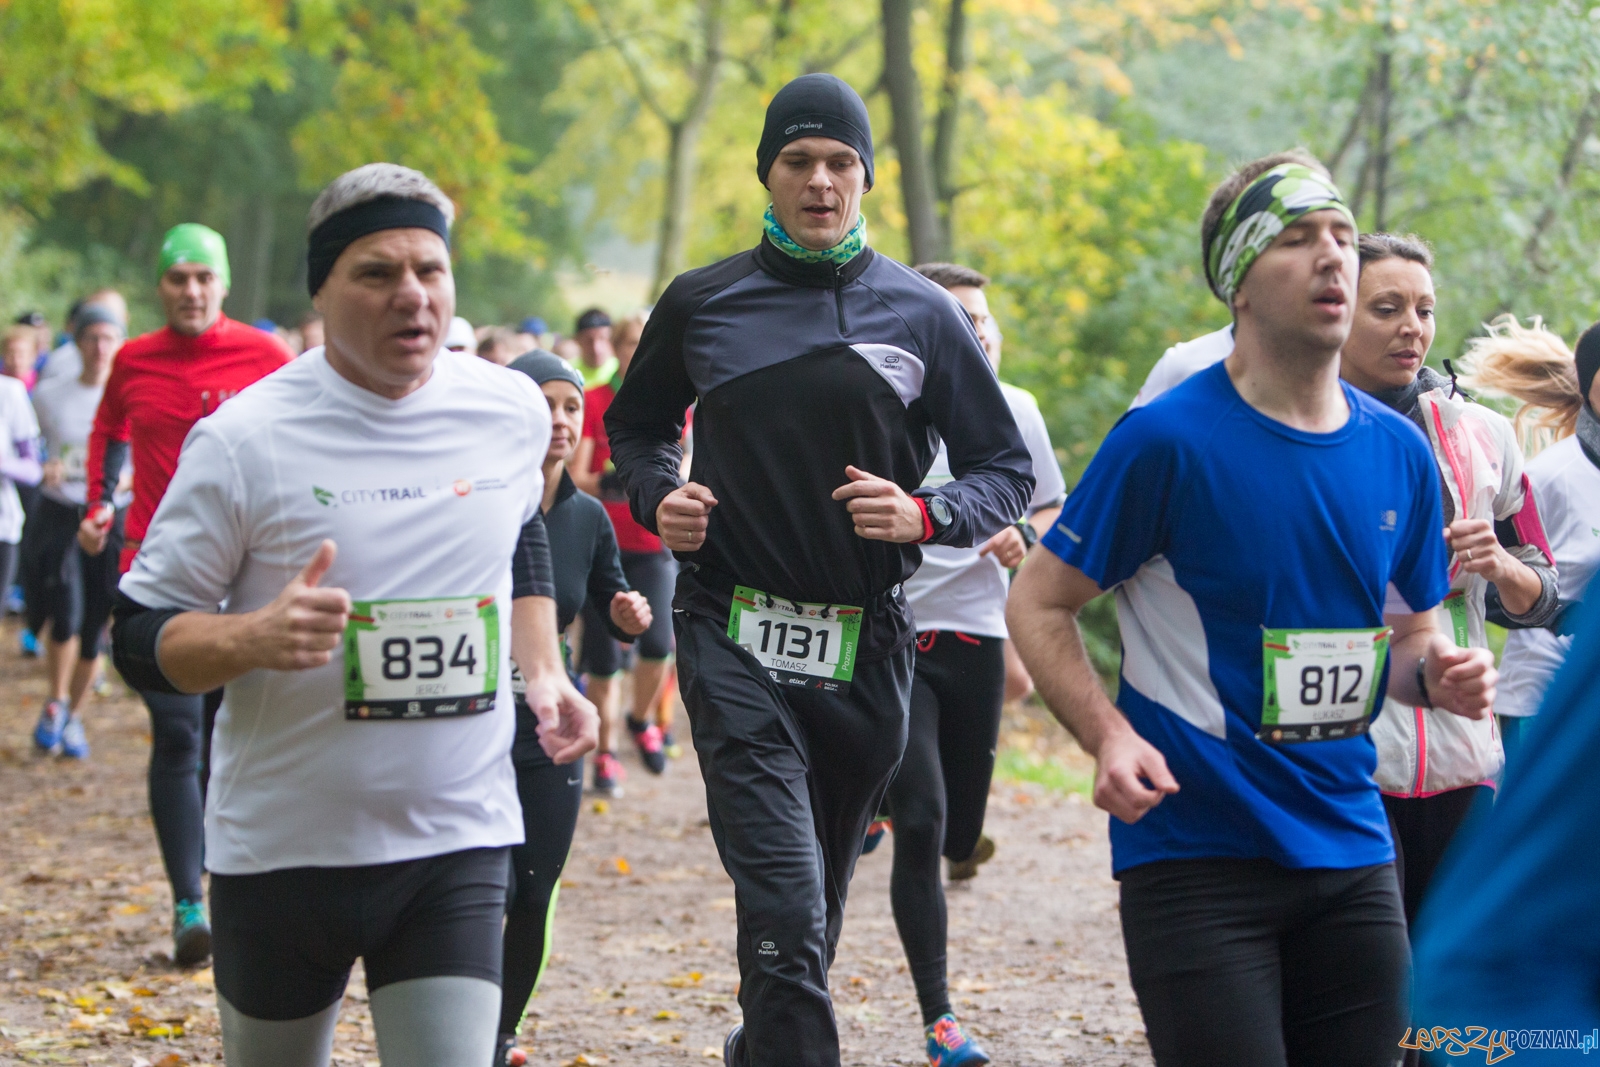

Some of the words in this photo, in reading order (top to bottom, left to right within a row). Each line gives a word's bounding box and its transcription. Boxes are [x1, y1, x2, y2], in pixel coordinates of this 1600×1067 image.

[800, 122, 823, 130] Kalenji
[382, 633, 477, 680] 834
[758, 620, 830, 663] 1131
[842, 641, 853, 671] Poznań
[771, 658, 807, 672] TOMASZ
[415, 683, 448, 696] JERZY
[1300, 664, 1363, 706] 812
